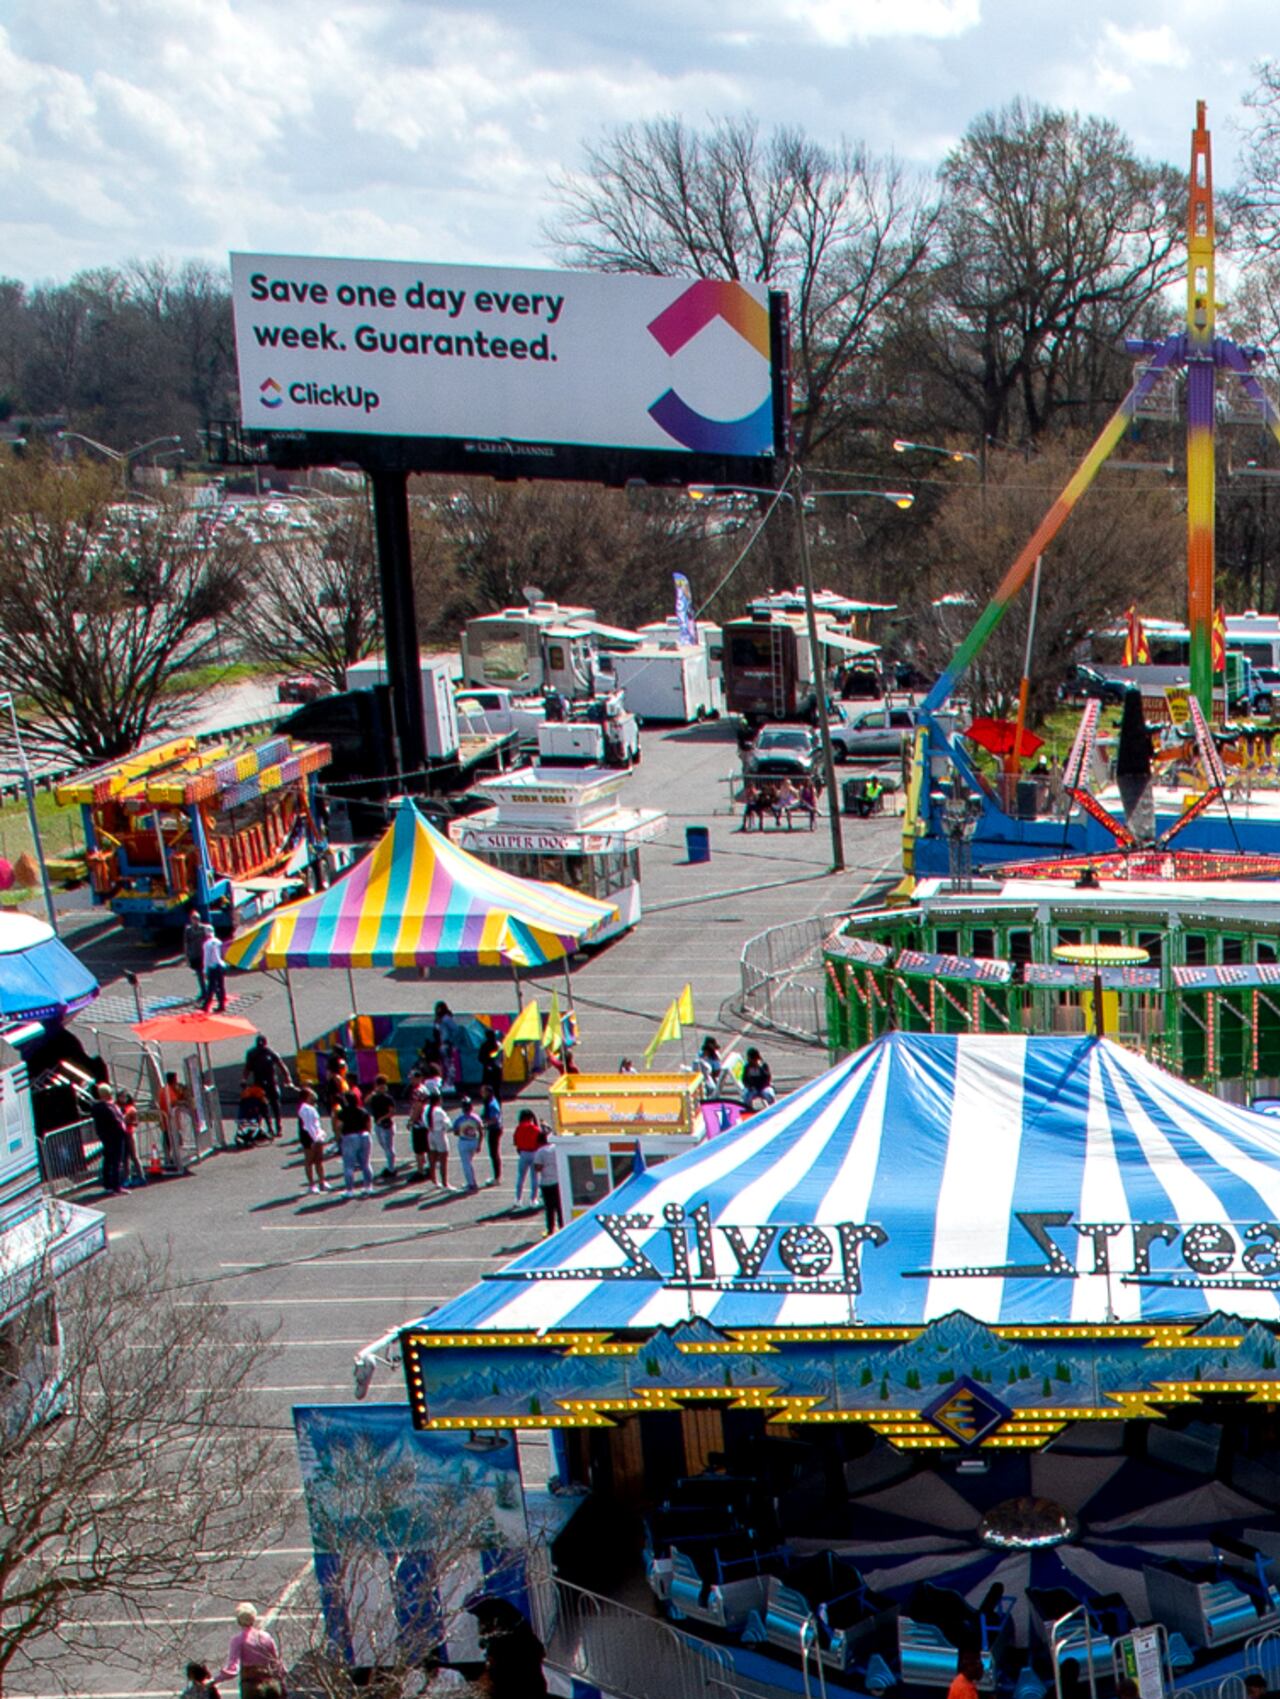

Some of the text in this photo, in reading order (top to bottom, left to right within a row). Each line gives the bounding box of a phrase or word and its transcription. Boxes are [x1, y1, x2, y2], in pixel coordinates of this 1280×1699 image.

[249, 274, 564, 323] Save one day every
[253, 322, 558, 362] week. Guaranteed.
[288, 383, 380, 411] ClickUp
[487, 833, 569, 849] SUPER DOG
[482, 1202, 888, 1294] Silver
